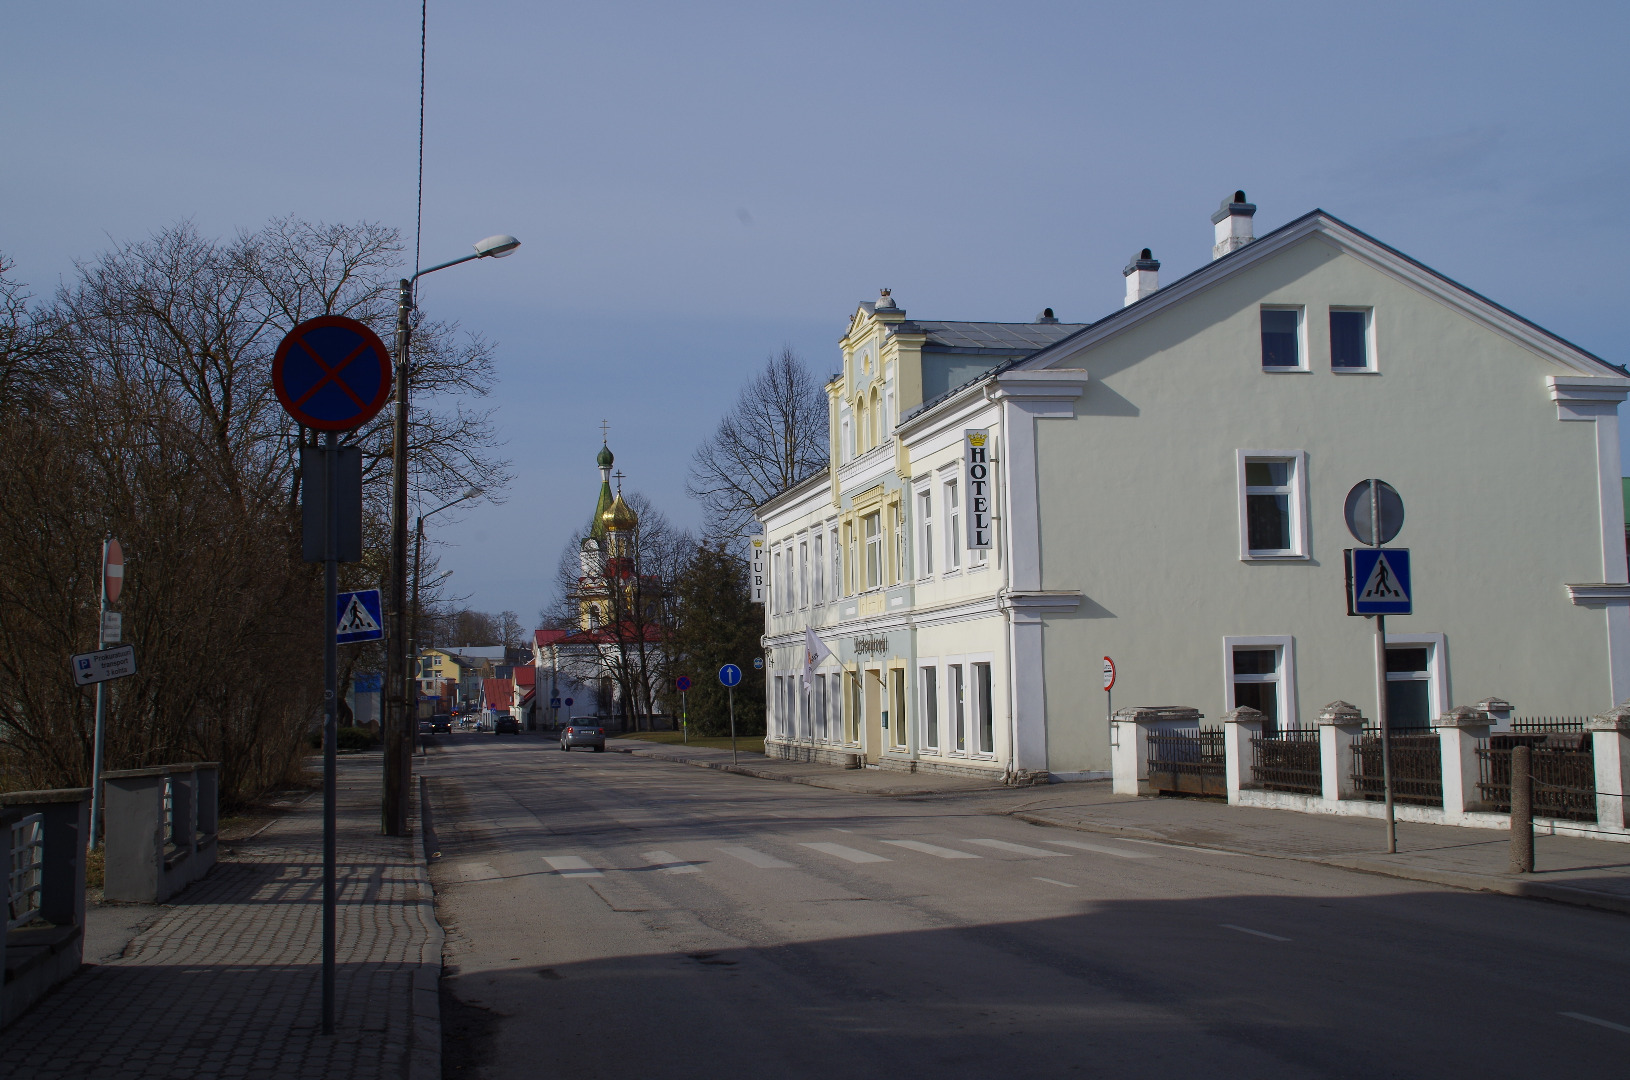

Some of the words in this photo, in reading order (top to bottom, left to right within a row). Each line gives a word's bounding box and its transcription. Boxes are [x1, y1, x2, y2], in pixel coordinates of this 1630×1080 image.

[970, 447, 989, 546] HOTELL
[754, 549, 763, 599] PUBI
[81, 660, 88, 669] P
[101, 658, 128, 669] transport
[106, 669, 111, 677] 3
[111, 667, 127, 675] kohta
